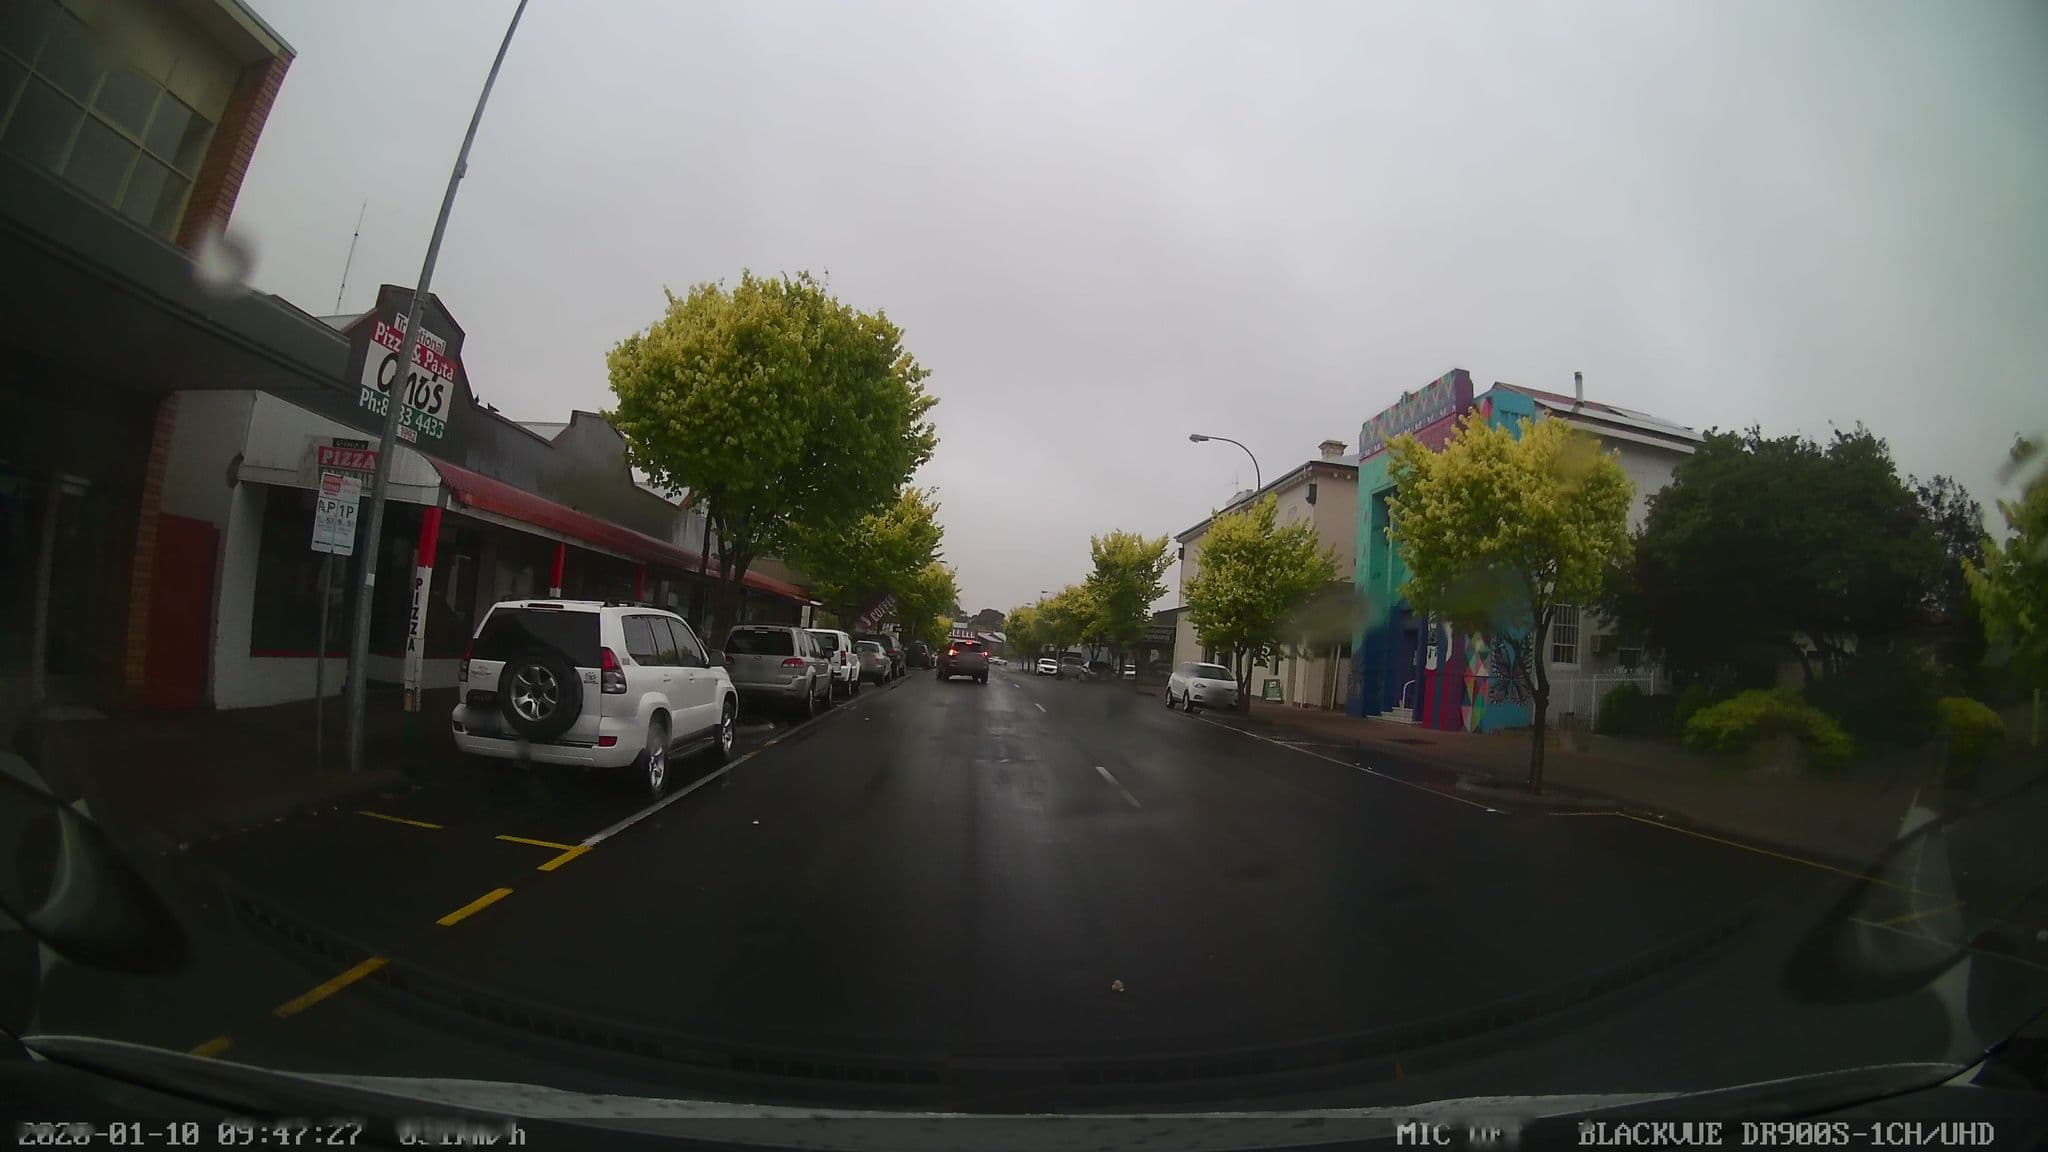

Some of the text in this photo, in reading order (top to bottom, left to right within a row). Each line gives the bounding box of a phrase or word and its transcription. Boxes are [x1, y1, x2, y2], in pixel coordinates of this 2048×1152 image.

[374, 320, 402, 352] Pizz
[424, 351, 454, 381] Pasta
[398, 314, 445, 353] Trtional
[377, 352, 445, 414] Gno's
[359, 387, 445, 439] Ph:833 4433
[322, 449, 377, 470] PIZZA
[340, 504, 354, 519] 1P
[407, 577, 423, 652] PIZZA
